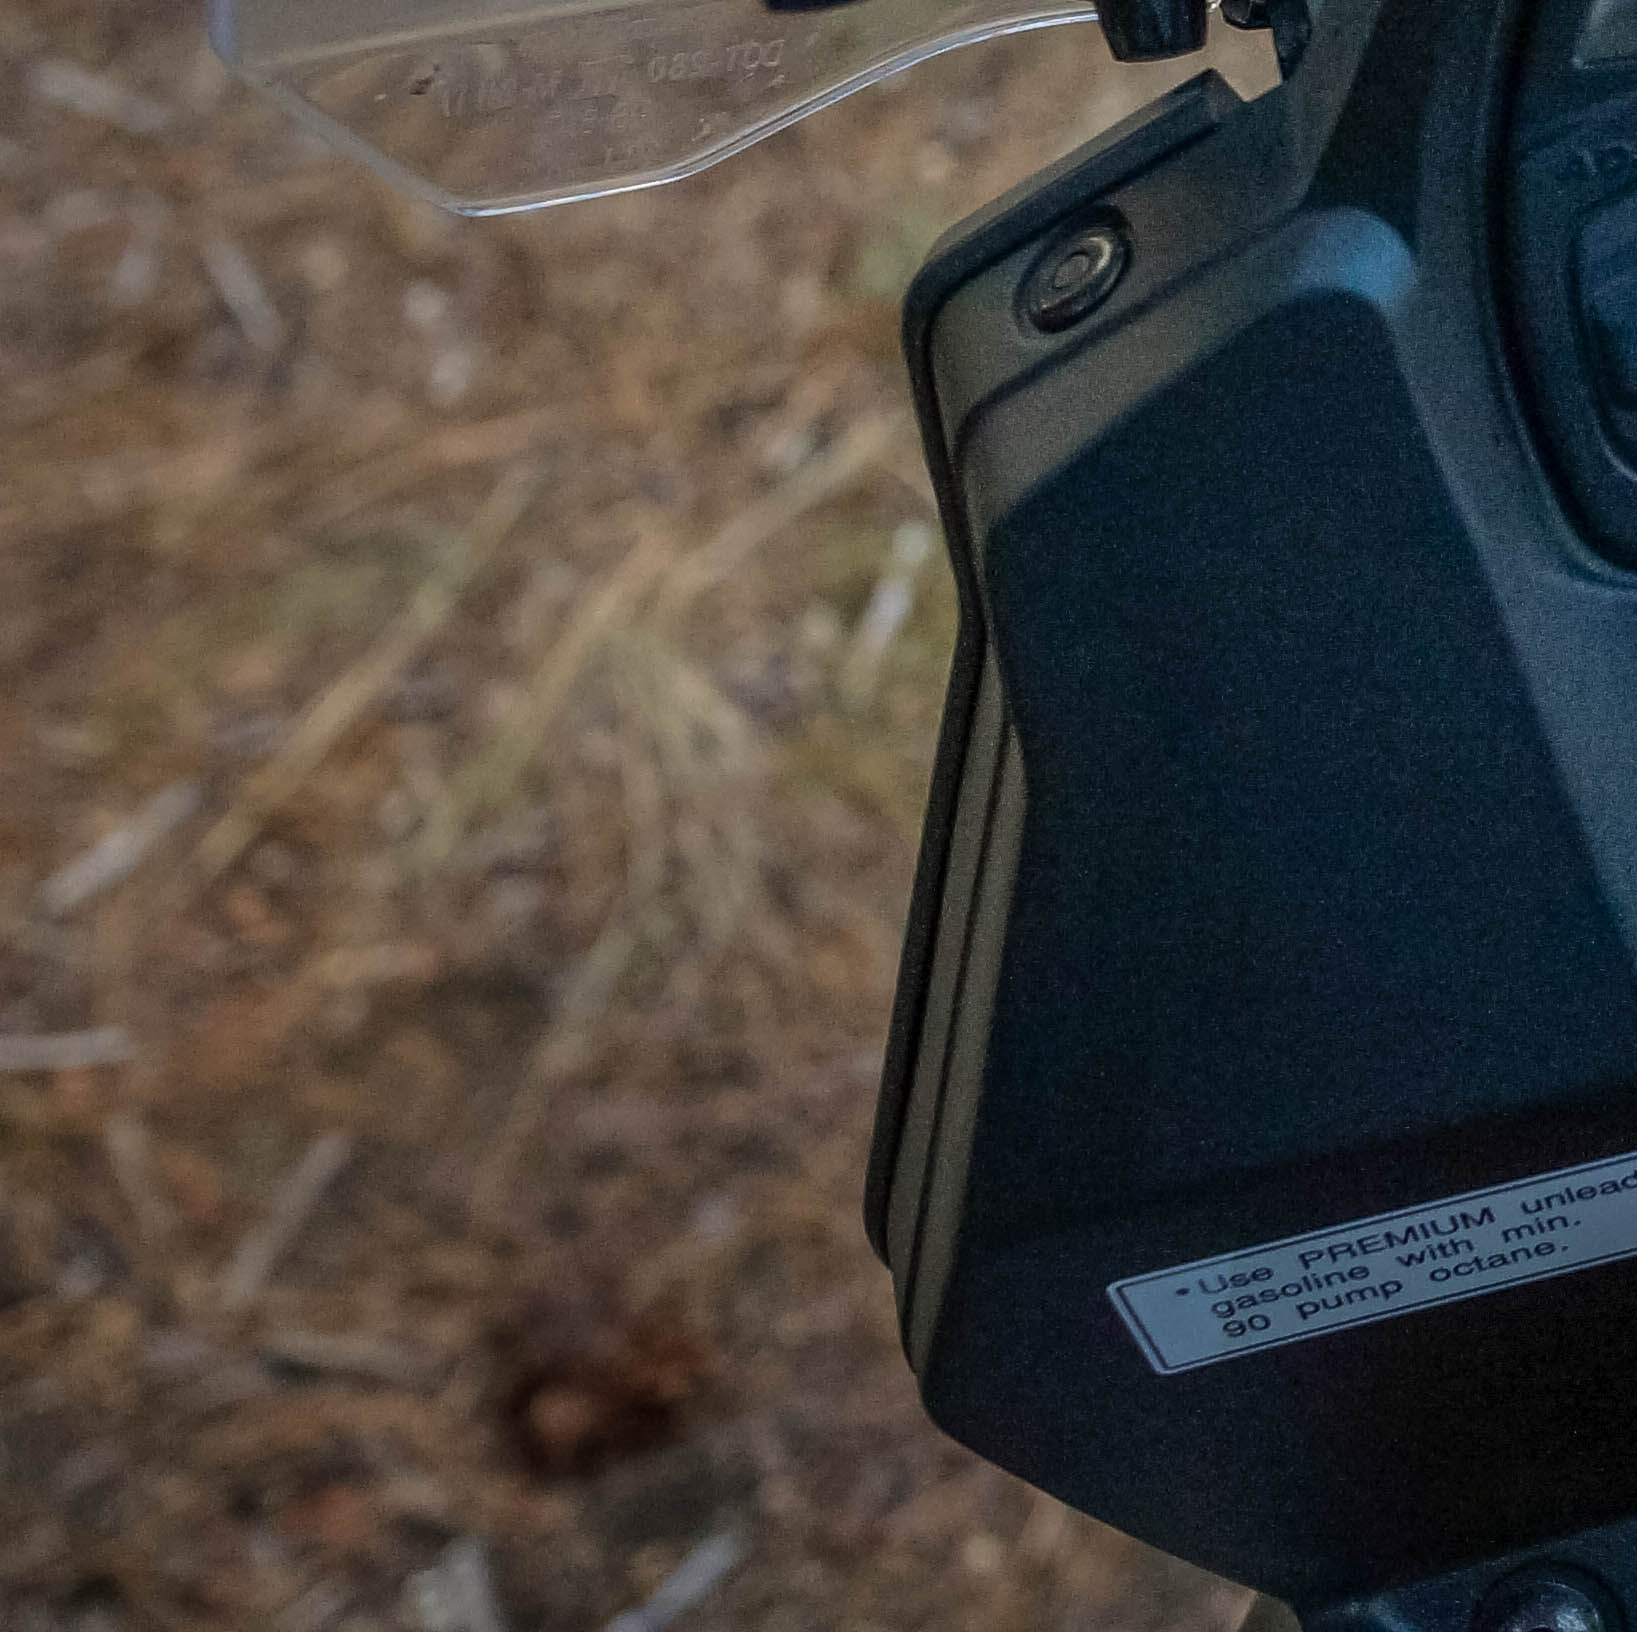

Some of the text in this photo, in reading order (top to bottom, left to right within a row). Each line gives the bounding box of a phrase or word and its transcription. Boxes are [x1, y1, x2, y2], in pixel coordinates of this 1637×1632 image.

[1198, 1266, 1274, 1294] Use
[1298, 1206, 1497, 1269] PREMIUM
[1211, 1213, 1582, 1319] gasoline with min.
[1222, 1239, 1569, 1338] 90 pump octane.
